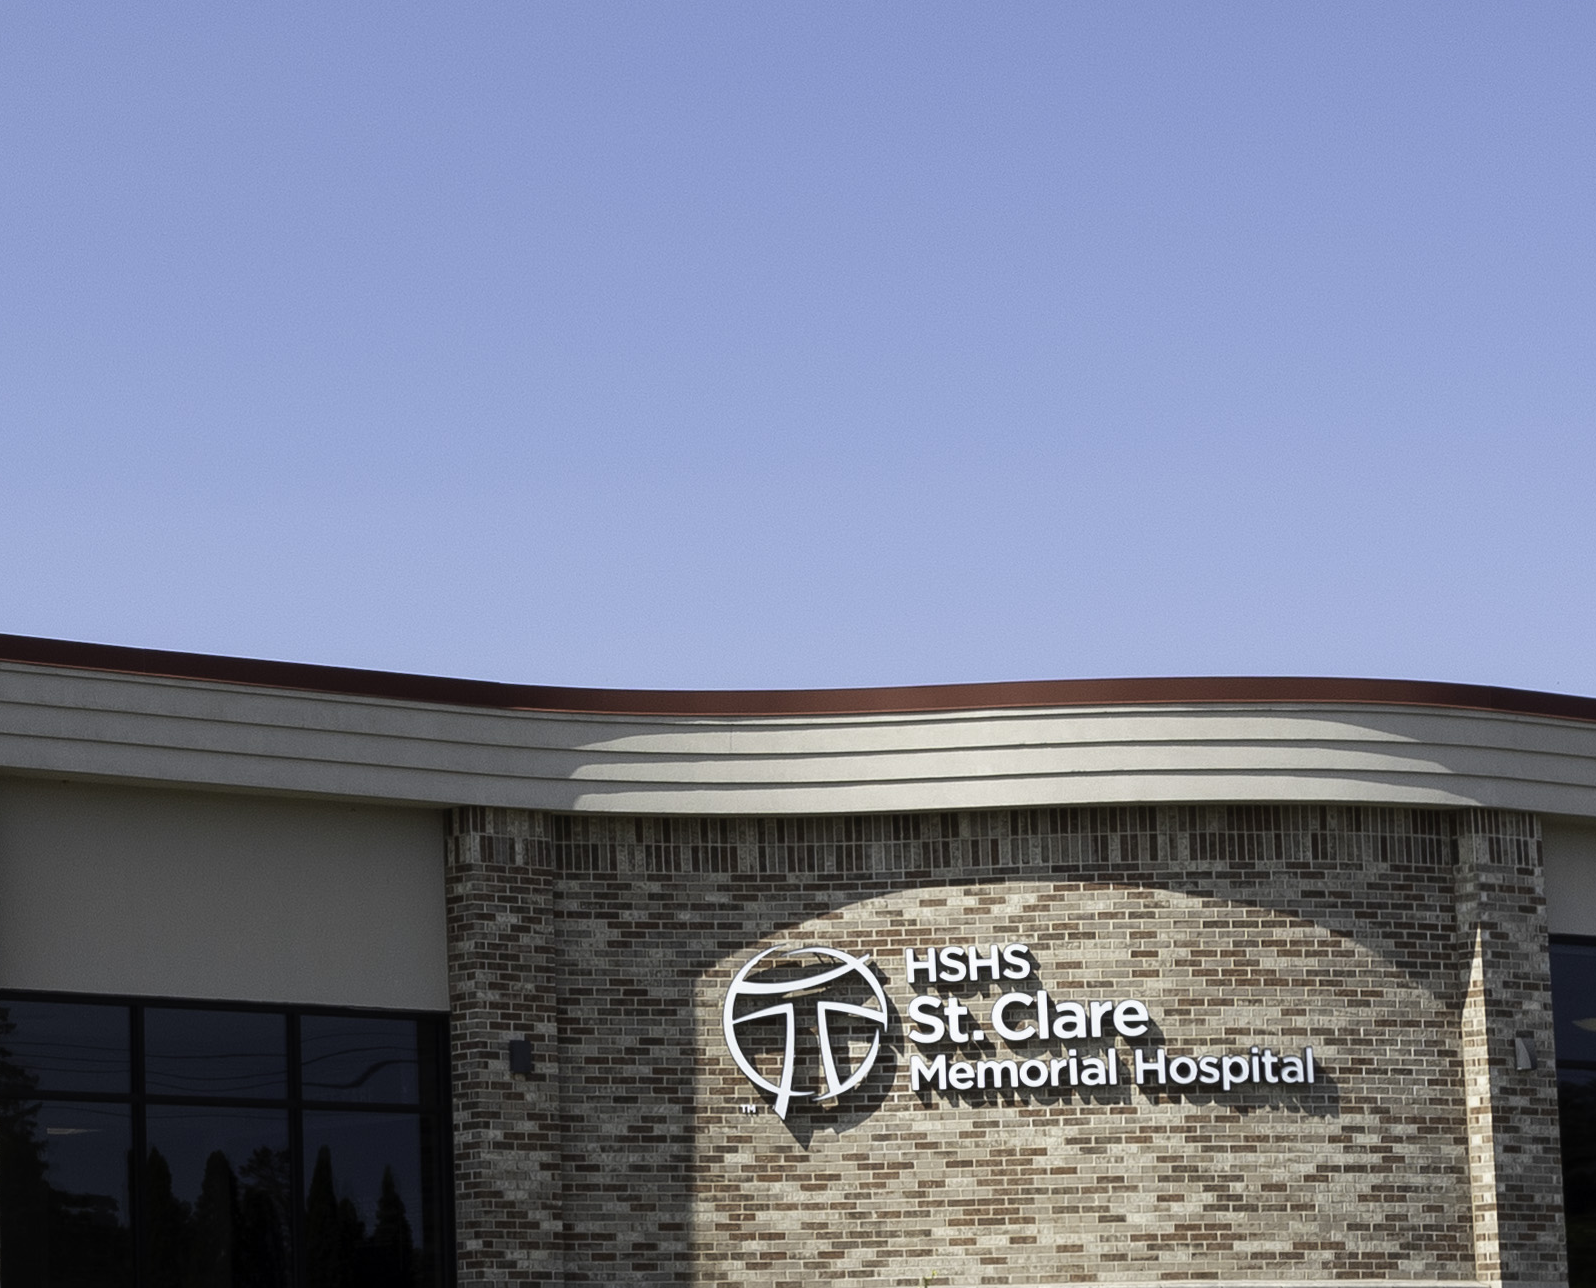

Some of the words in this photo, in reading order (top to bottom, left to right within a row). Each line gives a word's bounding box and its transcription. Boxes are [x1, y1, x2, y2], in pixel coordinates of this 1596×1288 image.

[905, 942, 1031, 984] HSHS
[907, 994, 984, 1044] St.
[990, 990, 1150, 1042] Clare
[910, 1048, 1118, 1091] Memorial
[1135, 1044, 1315, 1092] Hospital
